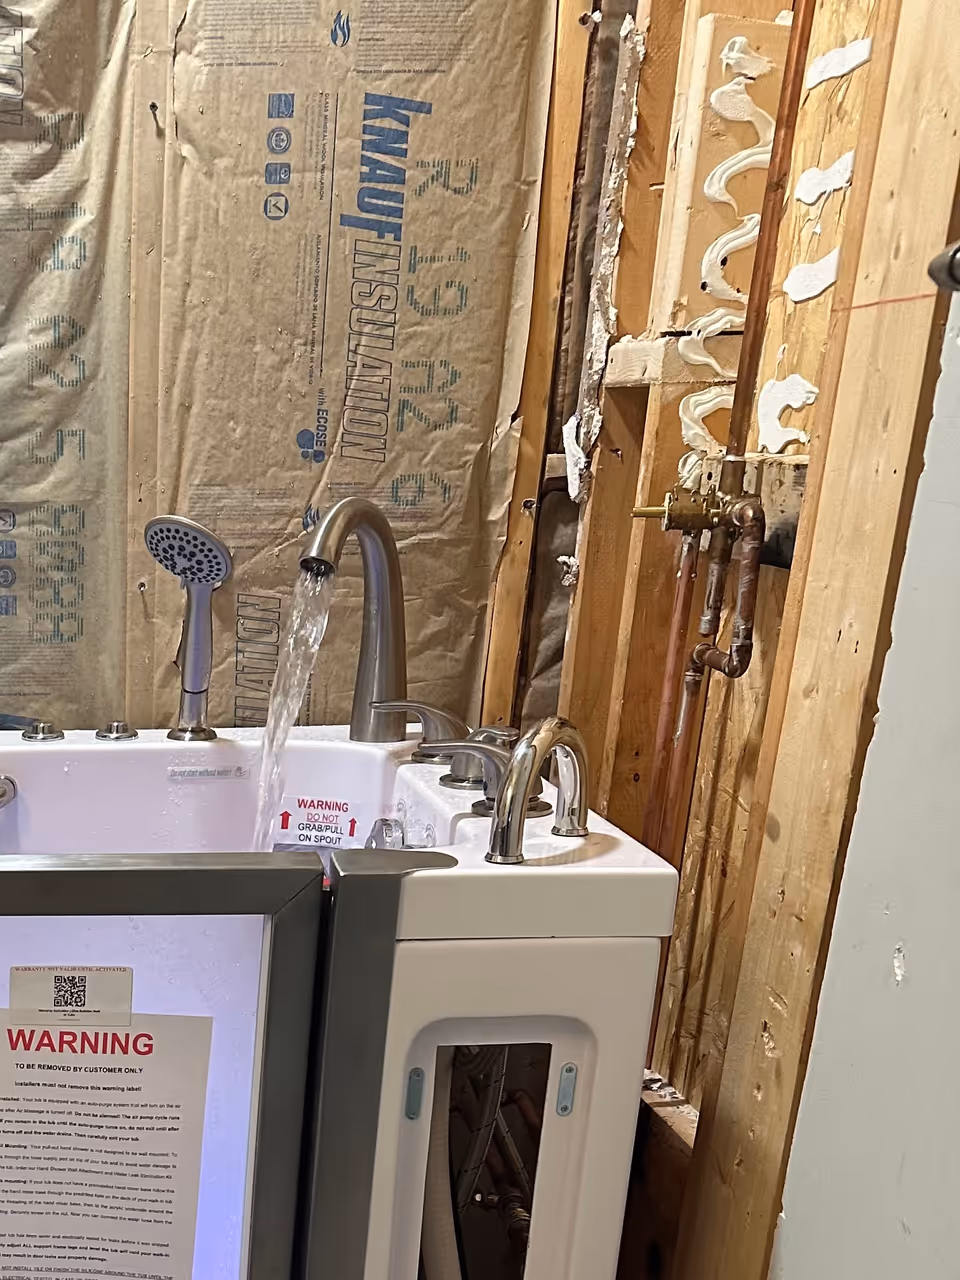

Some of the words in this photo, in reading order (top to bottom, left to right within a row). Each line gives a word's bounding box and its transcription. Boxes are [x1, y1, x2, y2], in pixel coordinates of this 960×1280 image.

[340, 92, 433, 241] KNAUF
[415, 158, 479, 197] R
[406, 245, 471, 318] 19
[340, 239, 402, 462] INSULATION
[397, 359, 462, 433] A2
[315, 409, 328, 447] ECOSE
[234, 593, 281, 726] LATION
[298, 799, 348, 812] WARNING
[307, 812, 320, 821] DO
[322, 814, 339, 822] NOT
[298, 823, 344, 835] GRAB/PULL
[314, 835, 342, 844] SPOUT
[6, 1028, 154, 1056] WARNING
[38, 1064, 71, 1072] REMOVED
